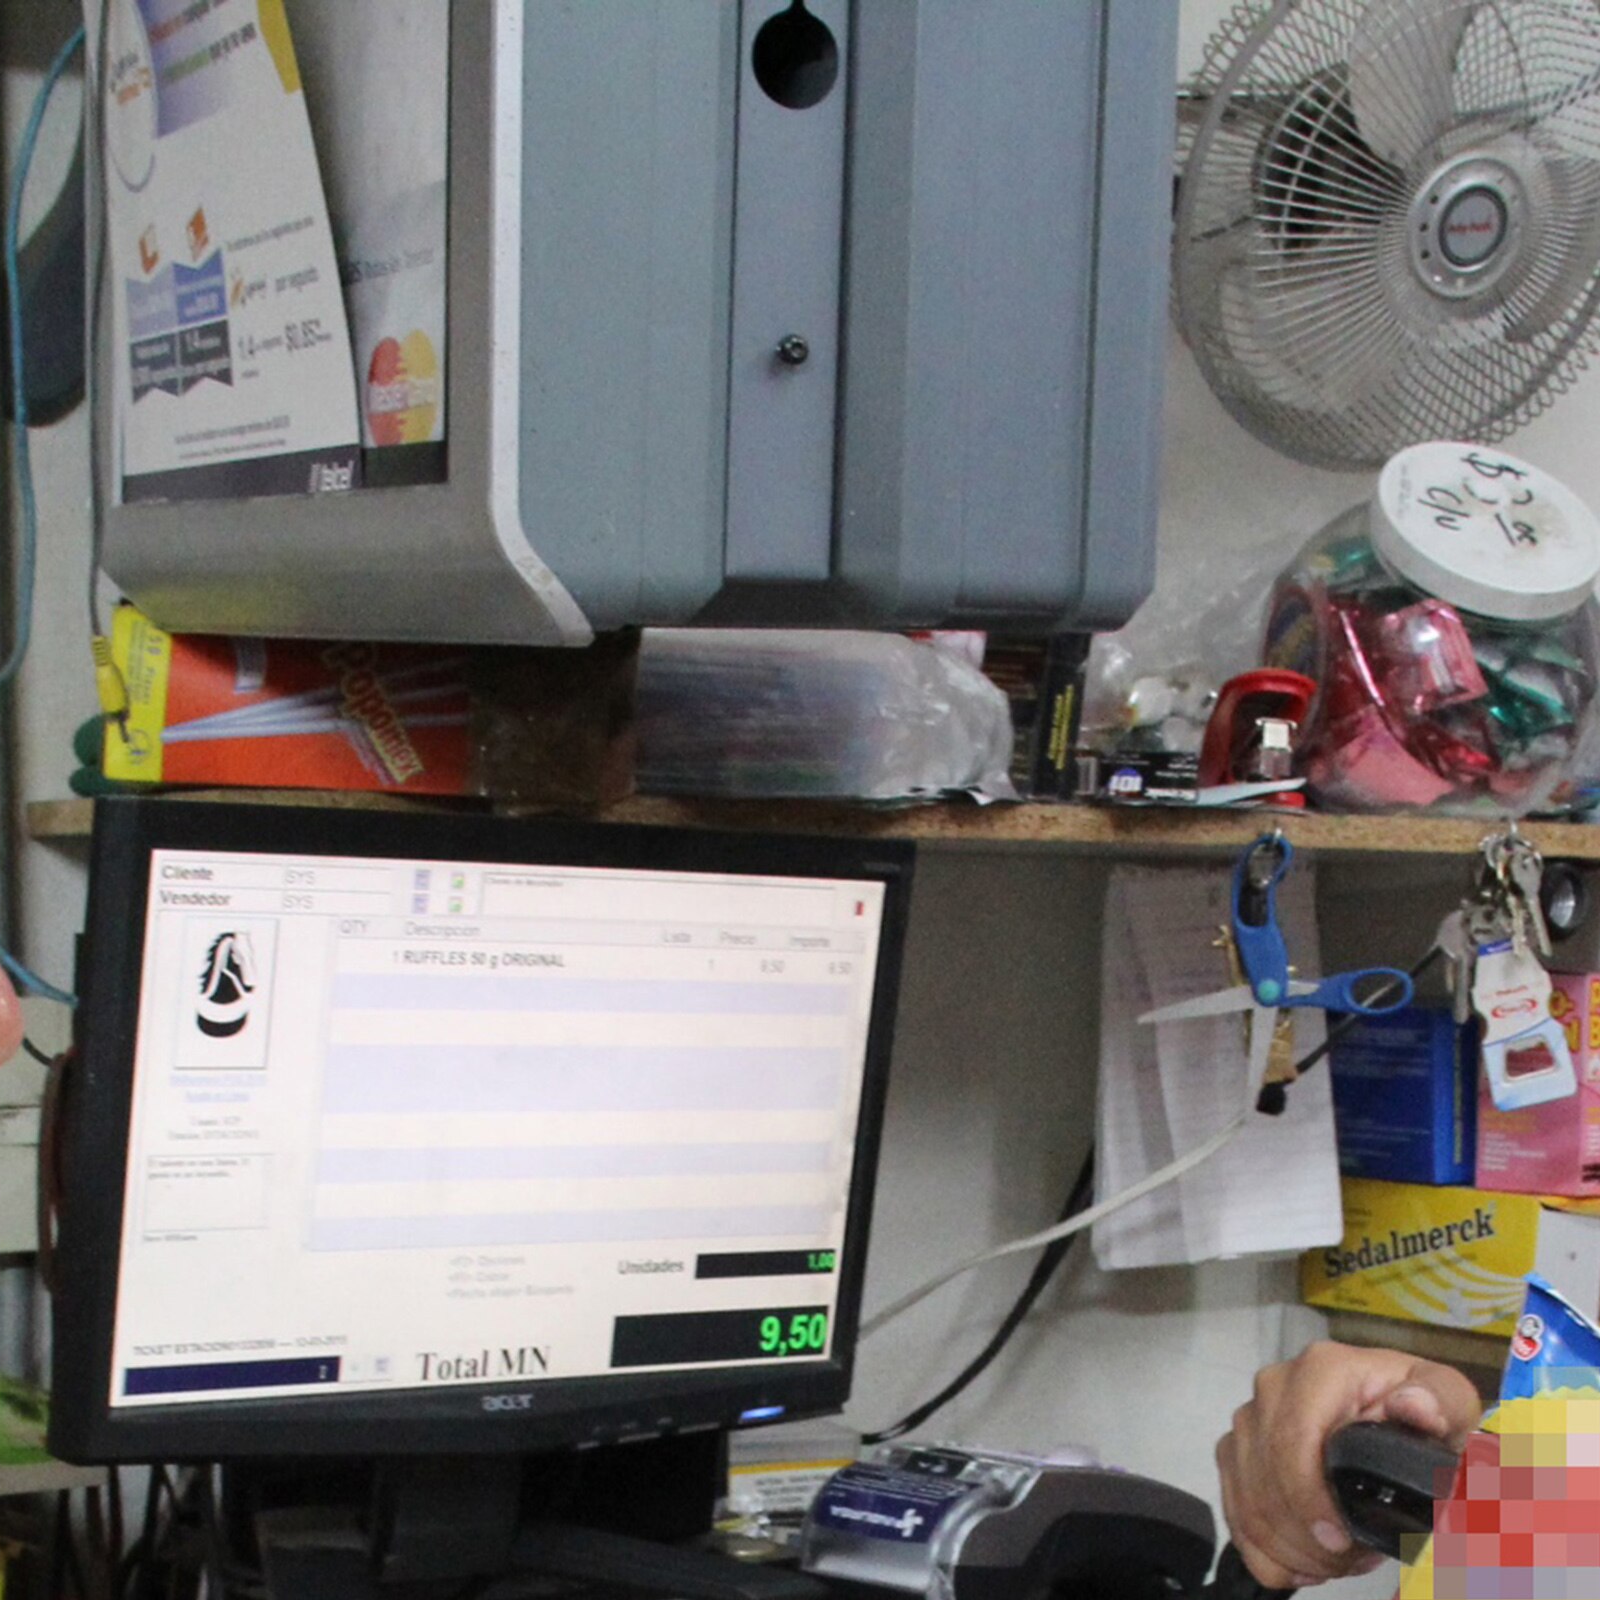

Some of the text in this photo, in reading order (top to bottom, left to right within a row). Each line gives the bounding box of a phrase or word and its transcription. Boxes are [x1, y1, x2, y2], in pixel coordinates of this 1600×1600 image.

[161, 866, 213, 881] Cliente
[159, 890, 231, 906] Vendedor
[404, 951, 467, 964] RUFFLES
[502, 952, 566, 968] ORIGINAL
[1323, 1210, 1496, 1281] Sedalmerck
[617, 1258, 685, 1274] Unidades
[758, 1311, 828, 1357] 9,50
[416, 1350, 489, 1382] Total
[496, 1344, 552, 1378] MN
